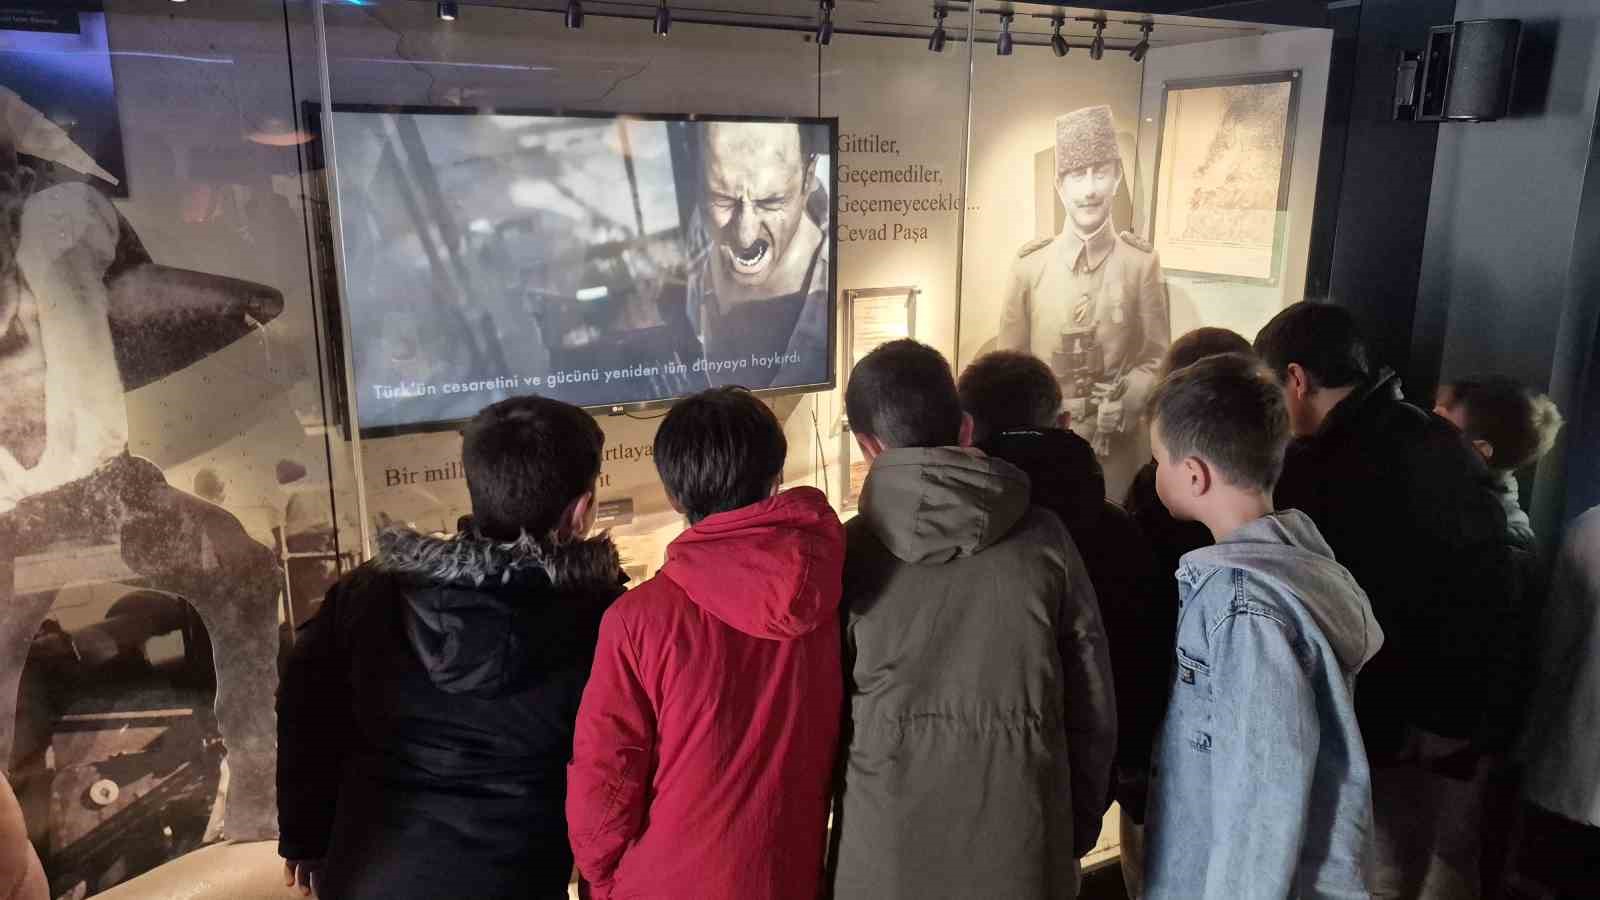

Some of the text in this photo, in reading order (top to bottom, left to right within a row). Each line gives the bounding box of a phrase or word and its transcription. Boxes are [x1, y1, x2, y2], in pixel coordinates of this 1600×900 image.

[838, 134, 900, 155] Gittiler,
[838, 164, 943, 187] Geçemediler,
[838, 193, 980, 216] Geçemeyecekle...
[838, 223, 928, 243] Cevad Paşa
[442, 375, 519, 394] cesaretini
[523, 376, 541, 387] ve
[547, 370, 600, 388] gücünü
[604, 364, 659, 383] yeniden
[664, 364, 688, 375] tüm
[692, 358, 747, 374] dünyaya
[384, 465, 418, 487] Bir
[424, 460, 465, 483] mill
